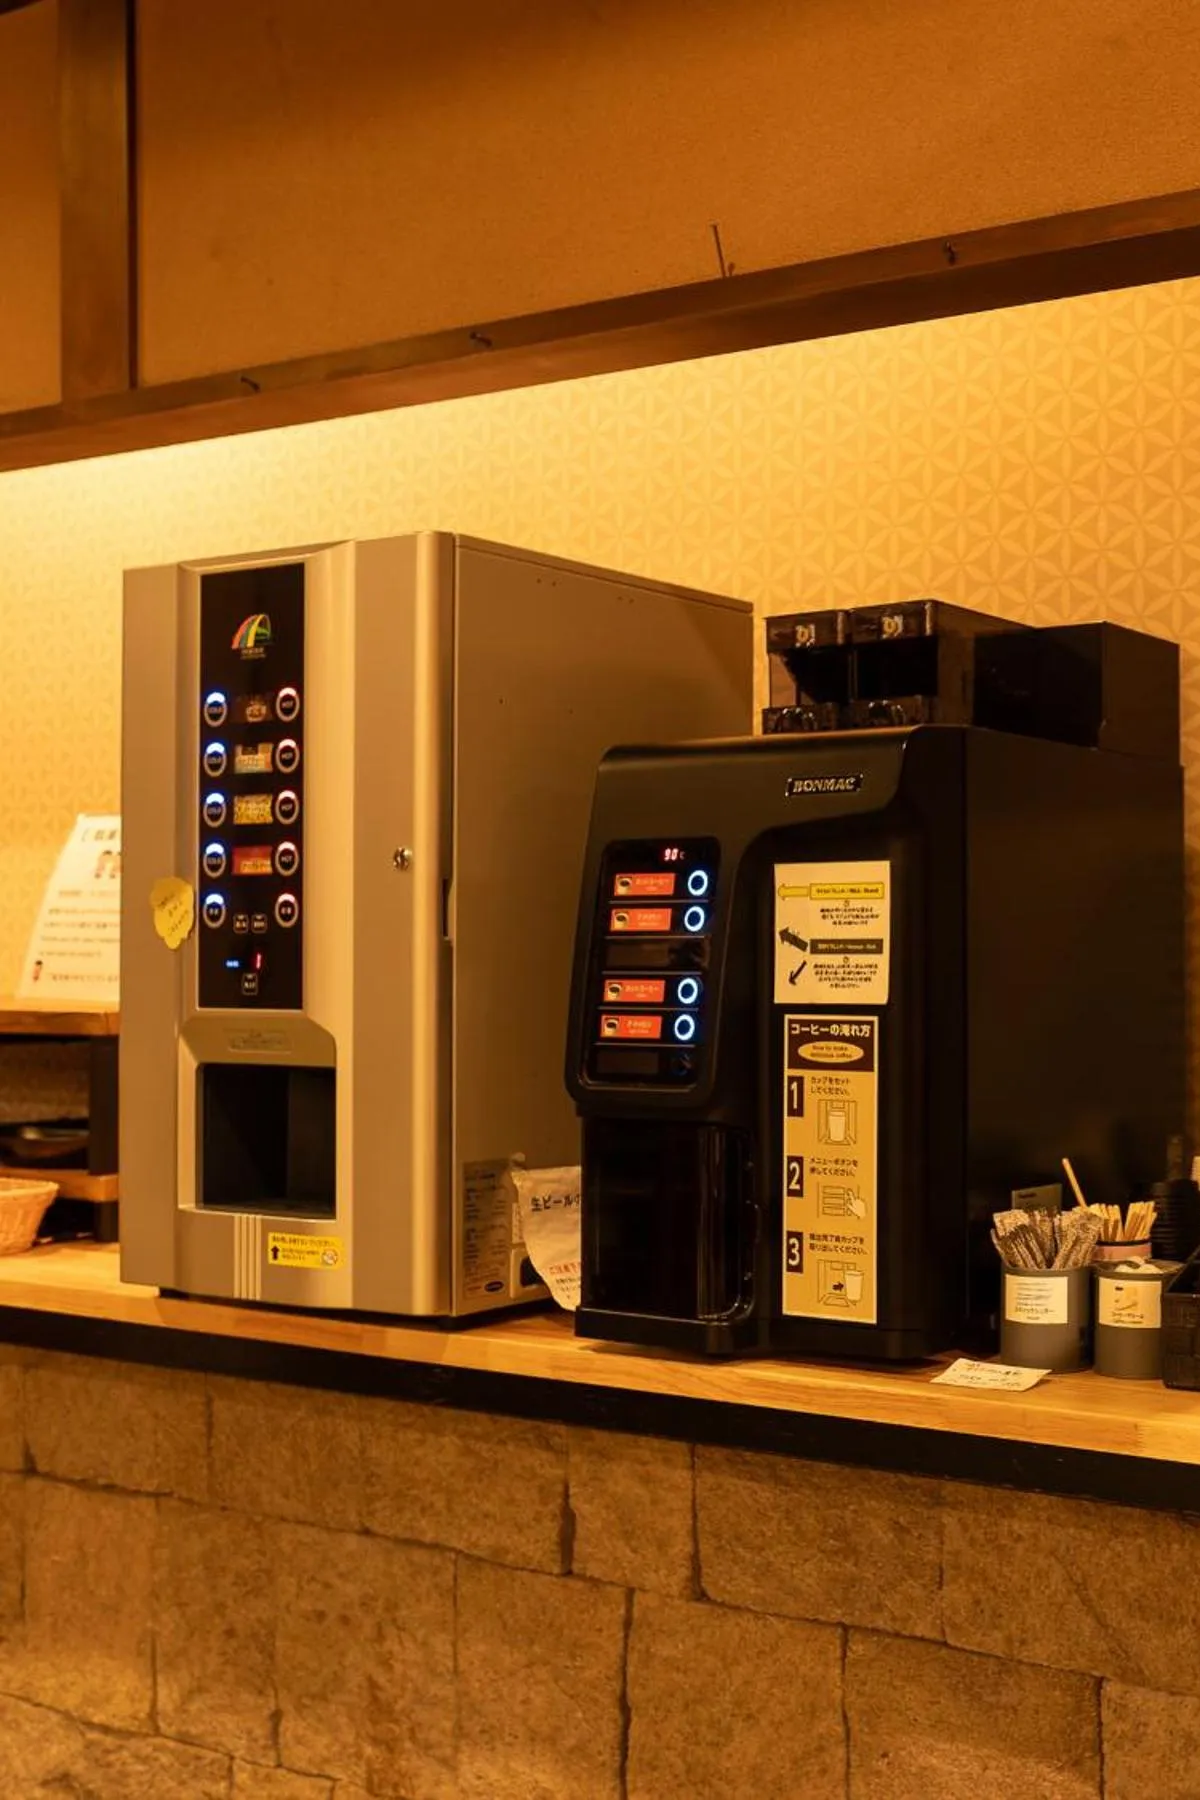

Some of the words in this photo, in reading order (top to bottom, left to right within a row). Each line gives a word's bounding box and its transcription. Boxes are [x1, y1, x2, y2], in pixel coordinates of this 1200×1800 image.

[793, 776, 855, 793] BONMAC
[790, 1081, 798, 1110] 1
[789, 1162, 801, 1190] 2
[788, 1237, 800, 1266] 3
